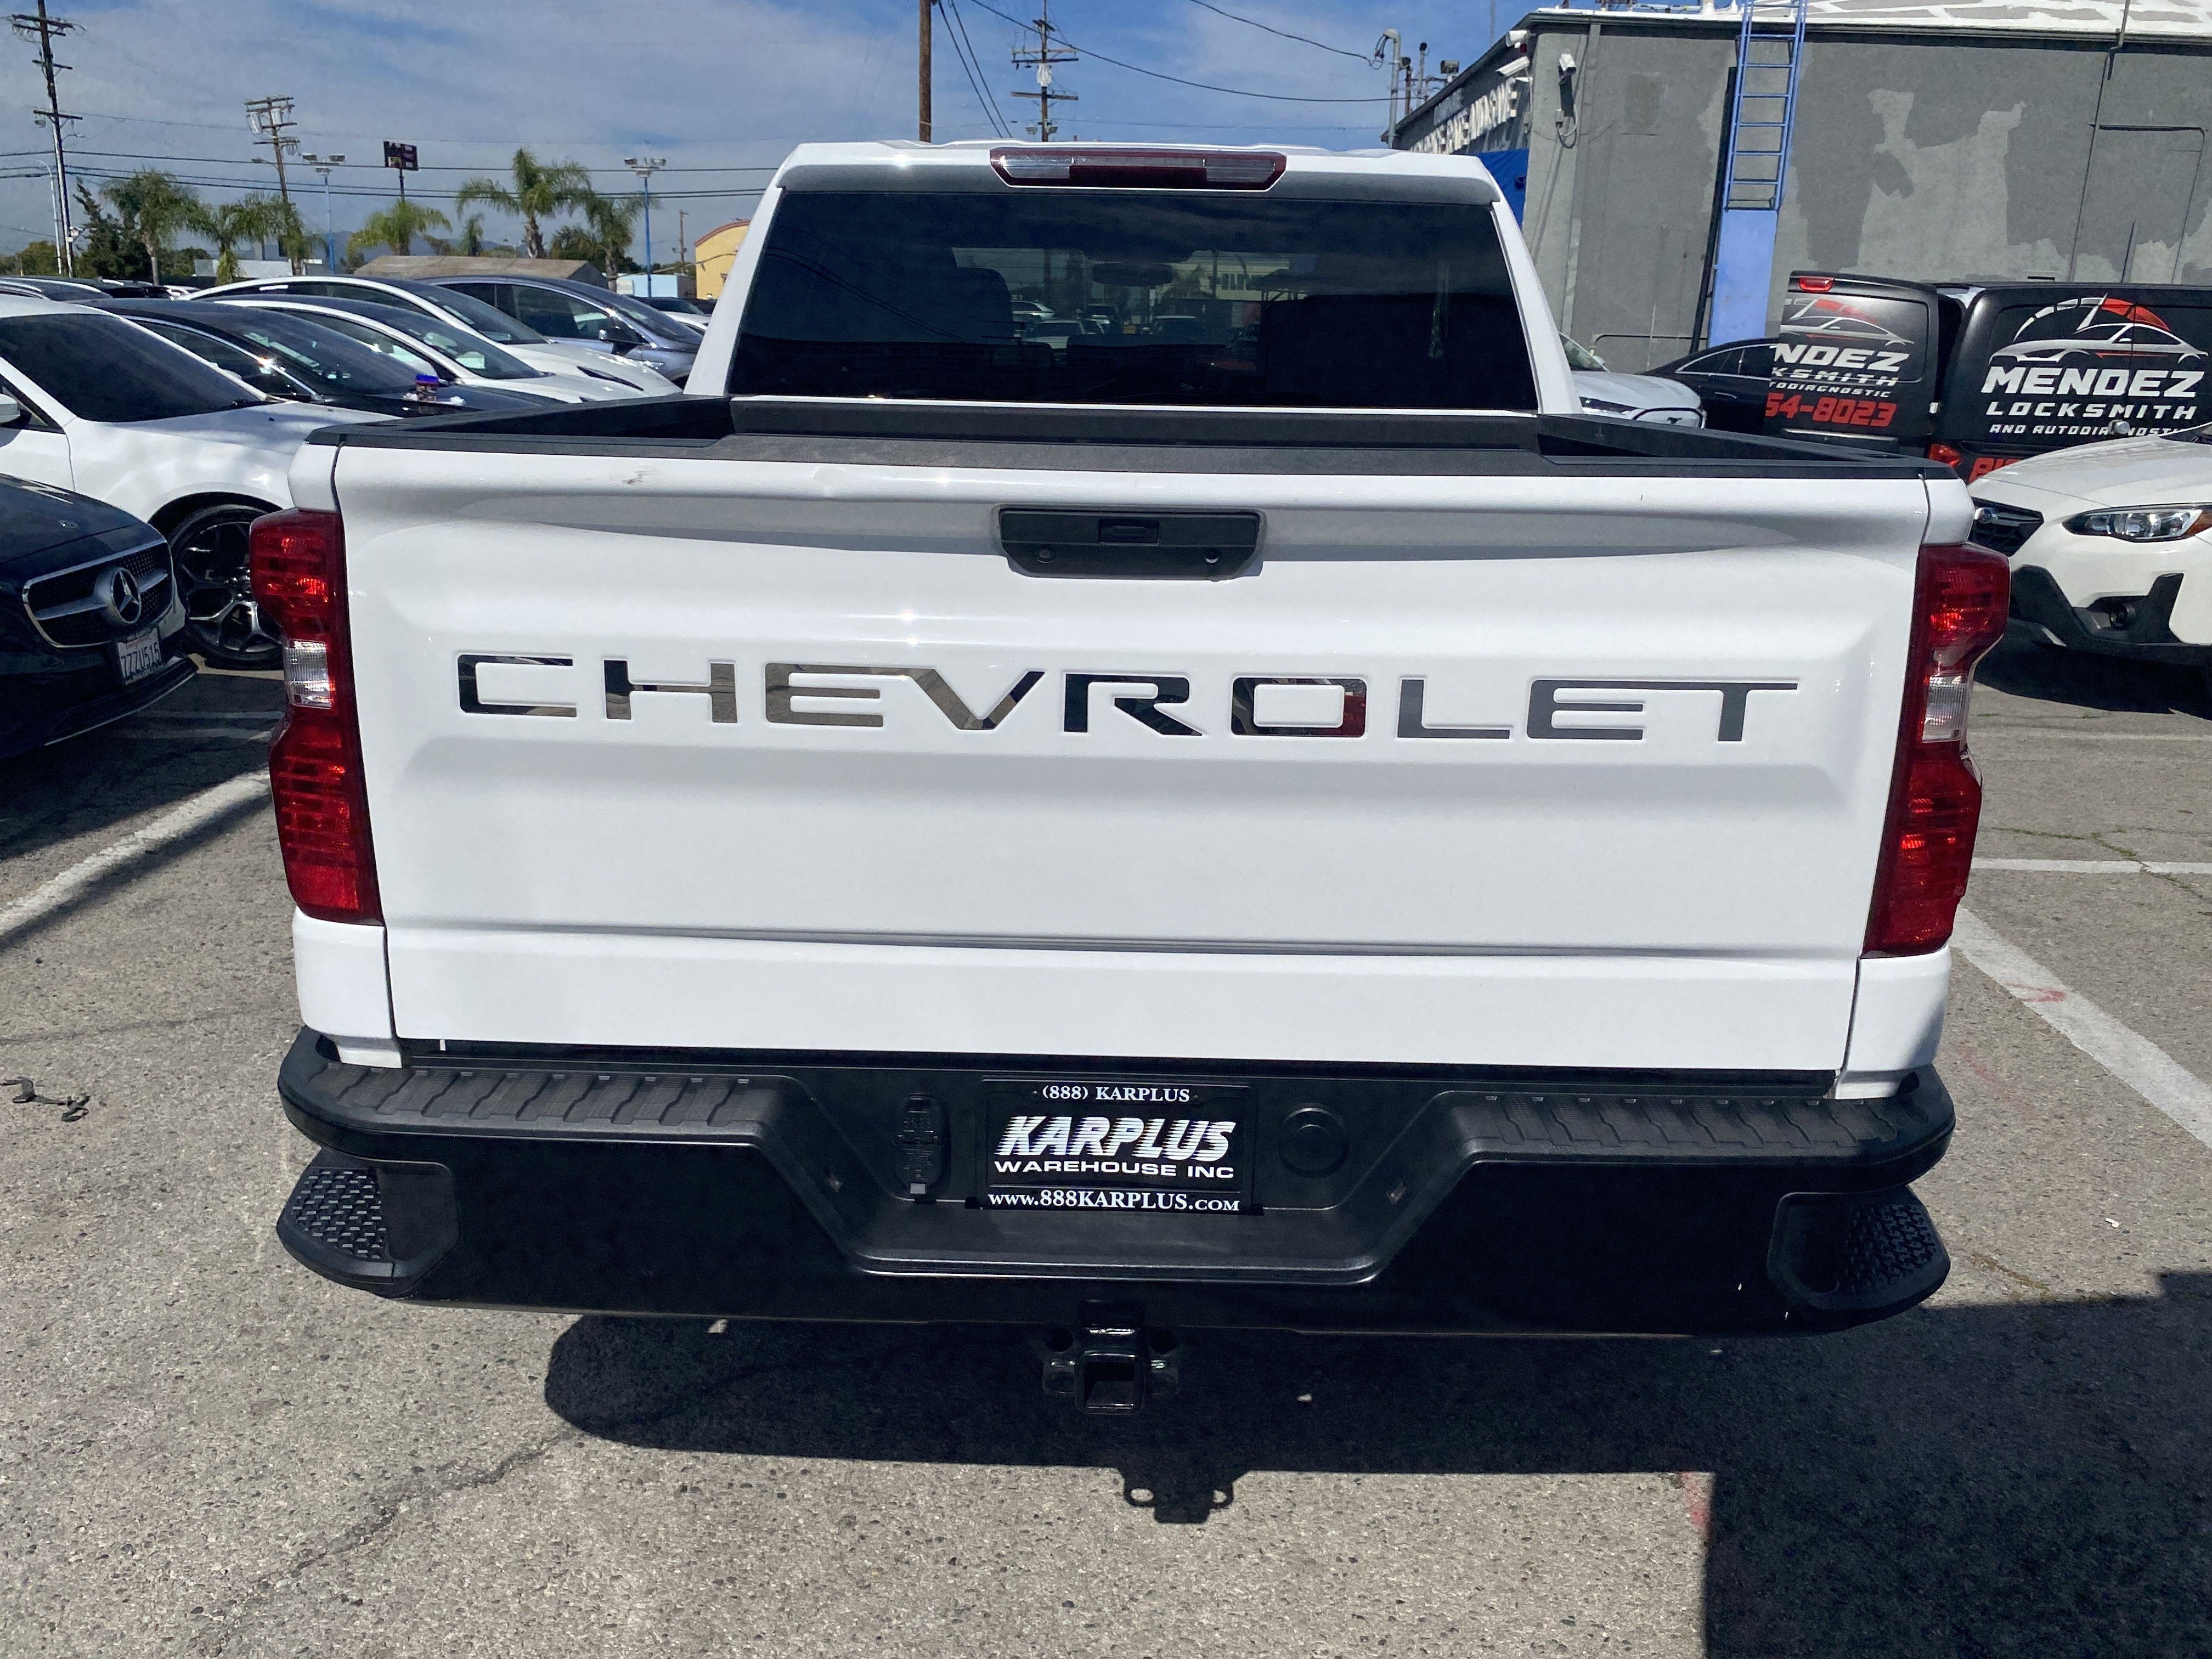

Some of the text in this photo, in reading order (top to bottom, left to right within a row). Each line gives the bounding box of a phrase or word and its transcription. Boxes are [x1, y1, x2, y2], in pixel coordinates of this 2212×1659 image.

[1981, 366, 2205, 398] MENDEZ
[1986, 401, 2197, 420] LOCKSMITH
[1989, 424, 2027, 435] AND
[458, 653, 1798, 741] CHEVROLET
[1042, 1085, 1190, 1102] (888) KARPLUS
[994, 1115, 1237, 1162] KARPLUS
[994, 1160, 1234, 1179] WAREHOUSE INC
